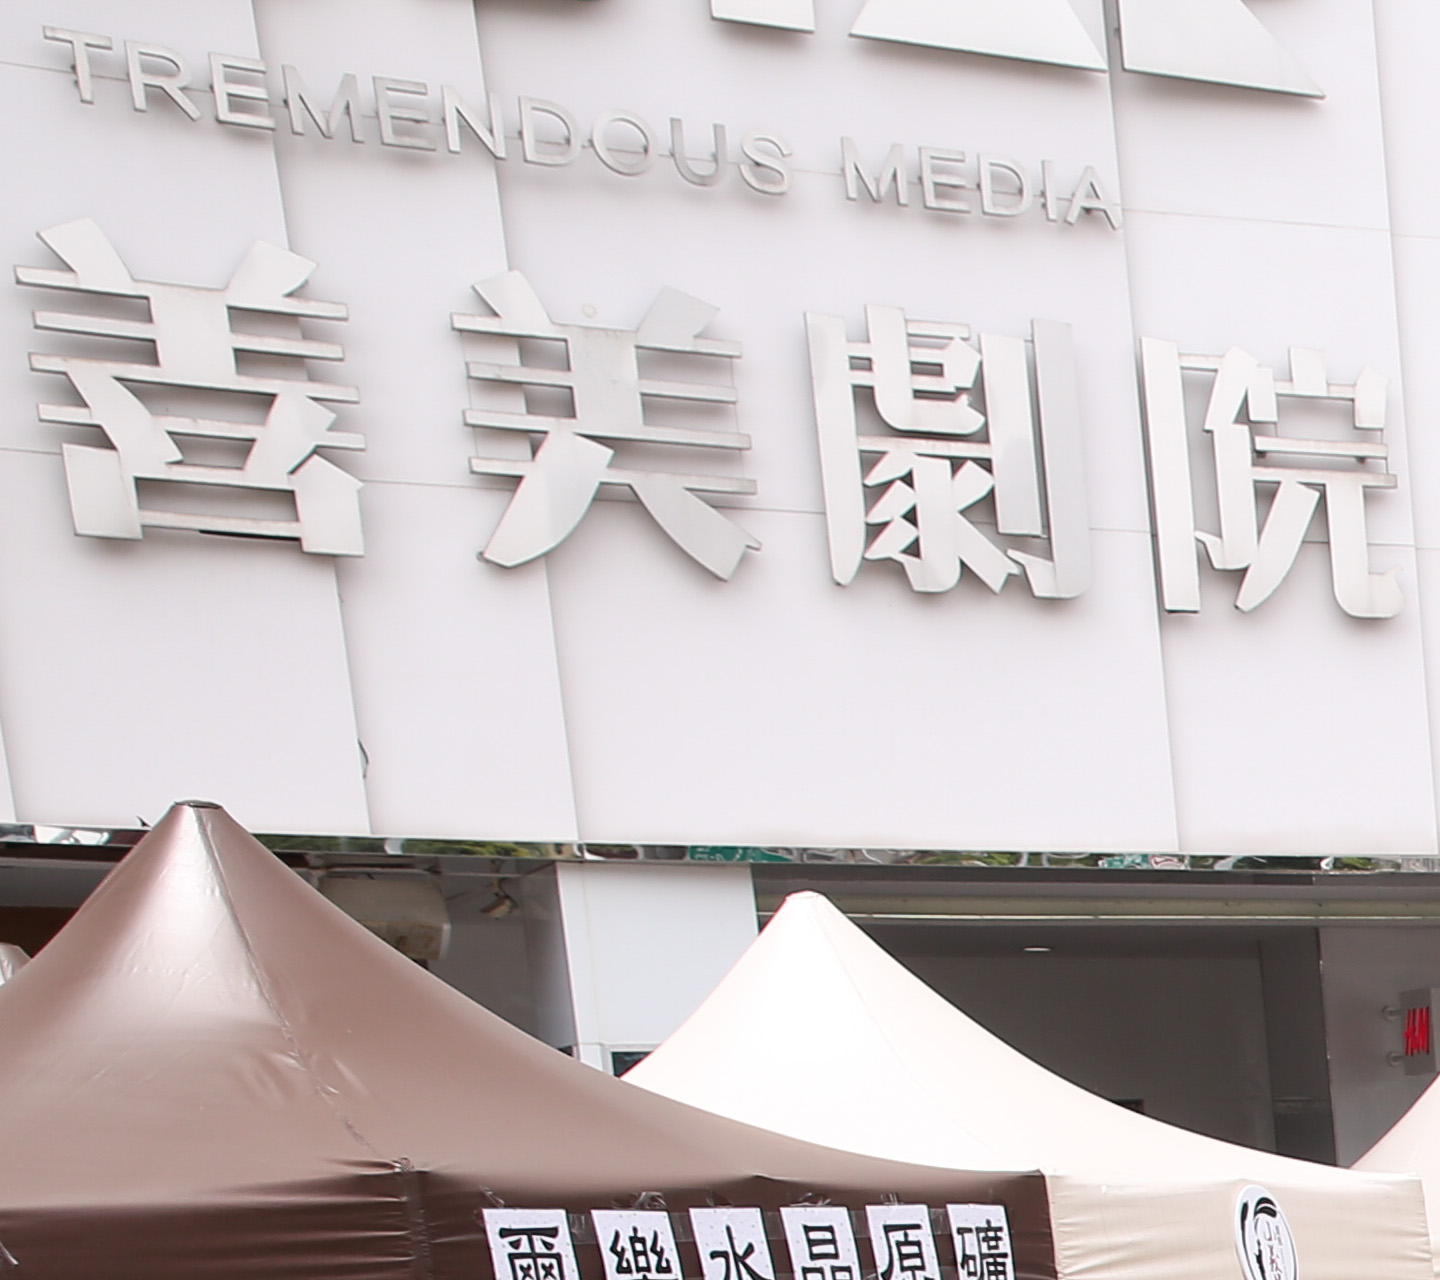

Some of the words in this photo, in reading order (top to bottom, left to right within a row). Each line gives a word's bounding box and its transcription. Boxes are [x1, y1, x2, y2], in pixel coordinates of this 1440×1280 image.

[42, 25, 794, 198] TREMENDOUS
[840, 135, 1123, 229] MEDIA
[13, 217, 1404, 620] 善美劇院
